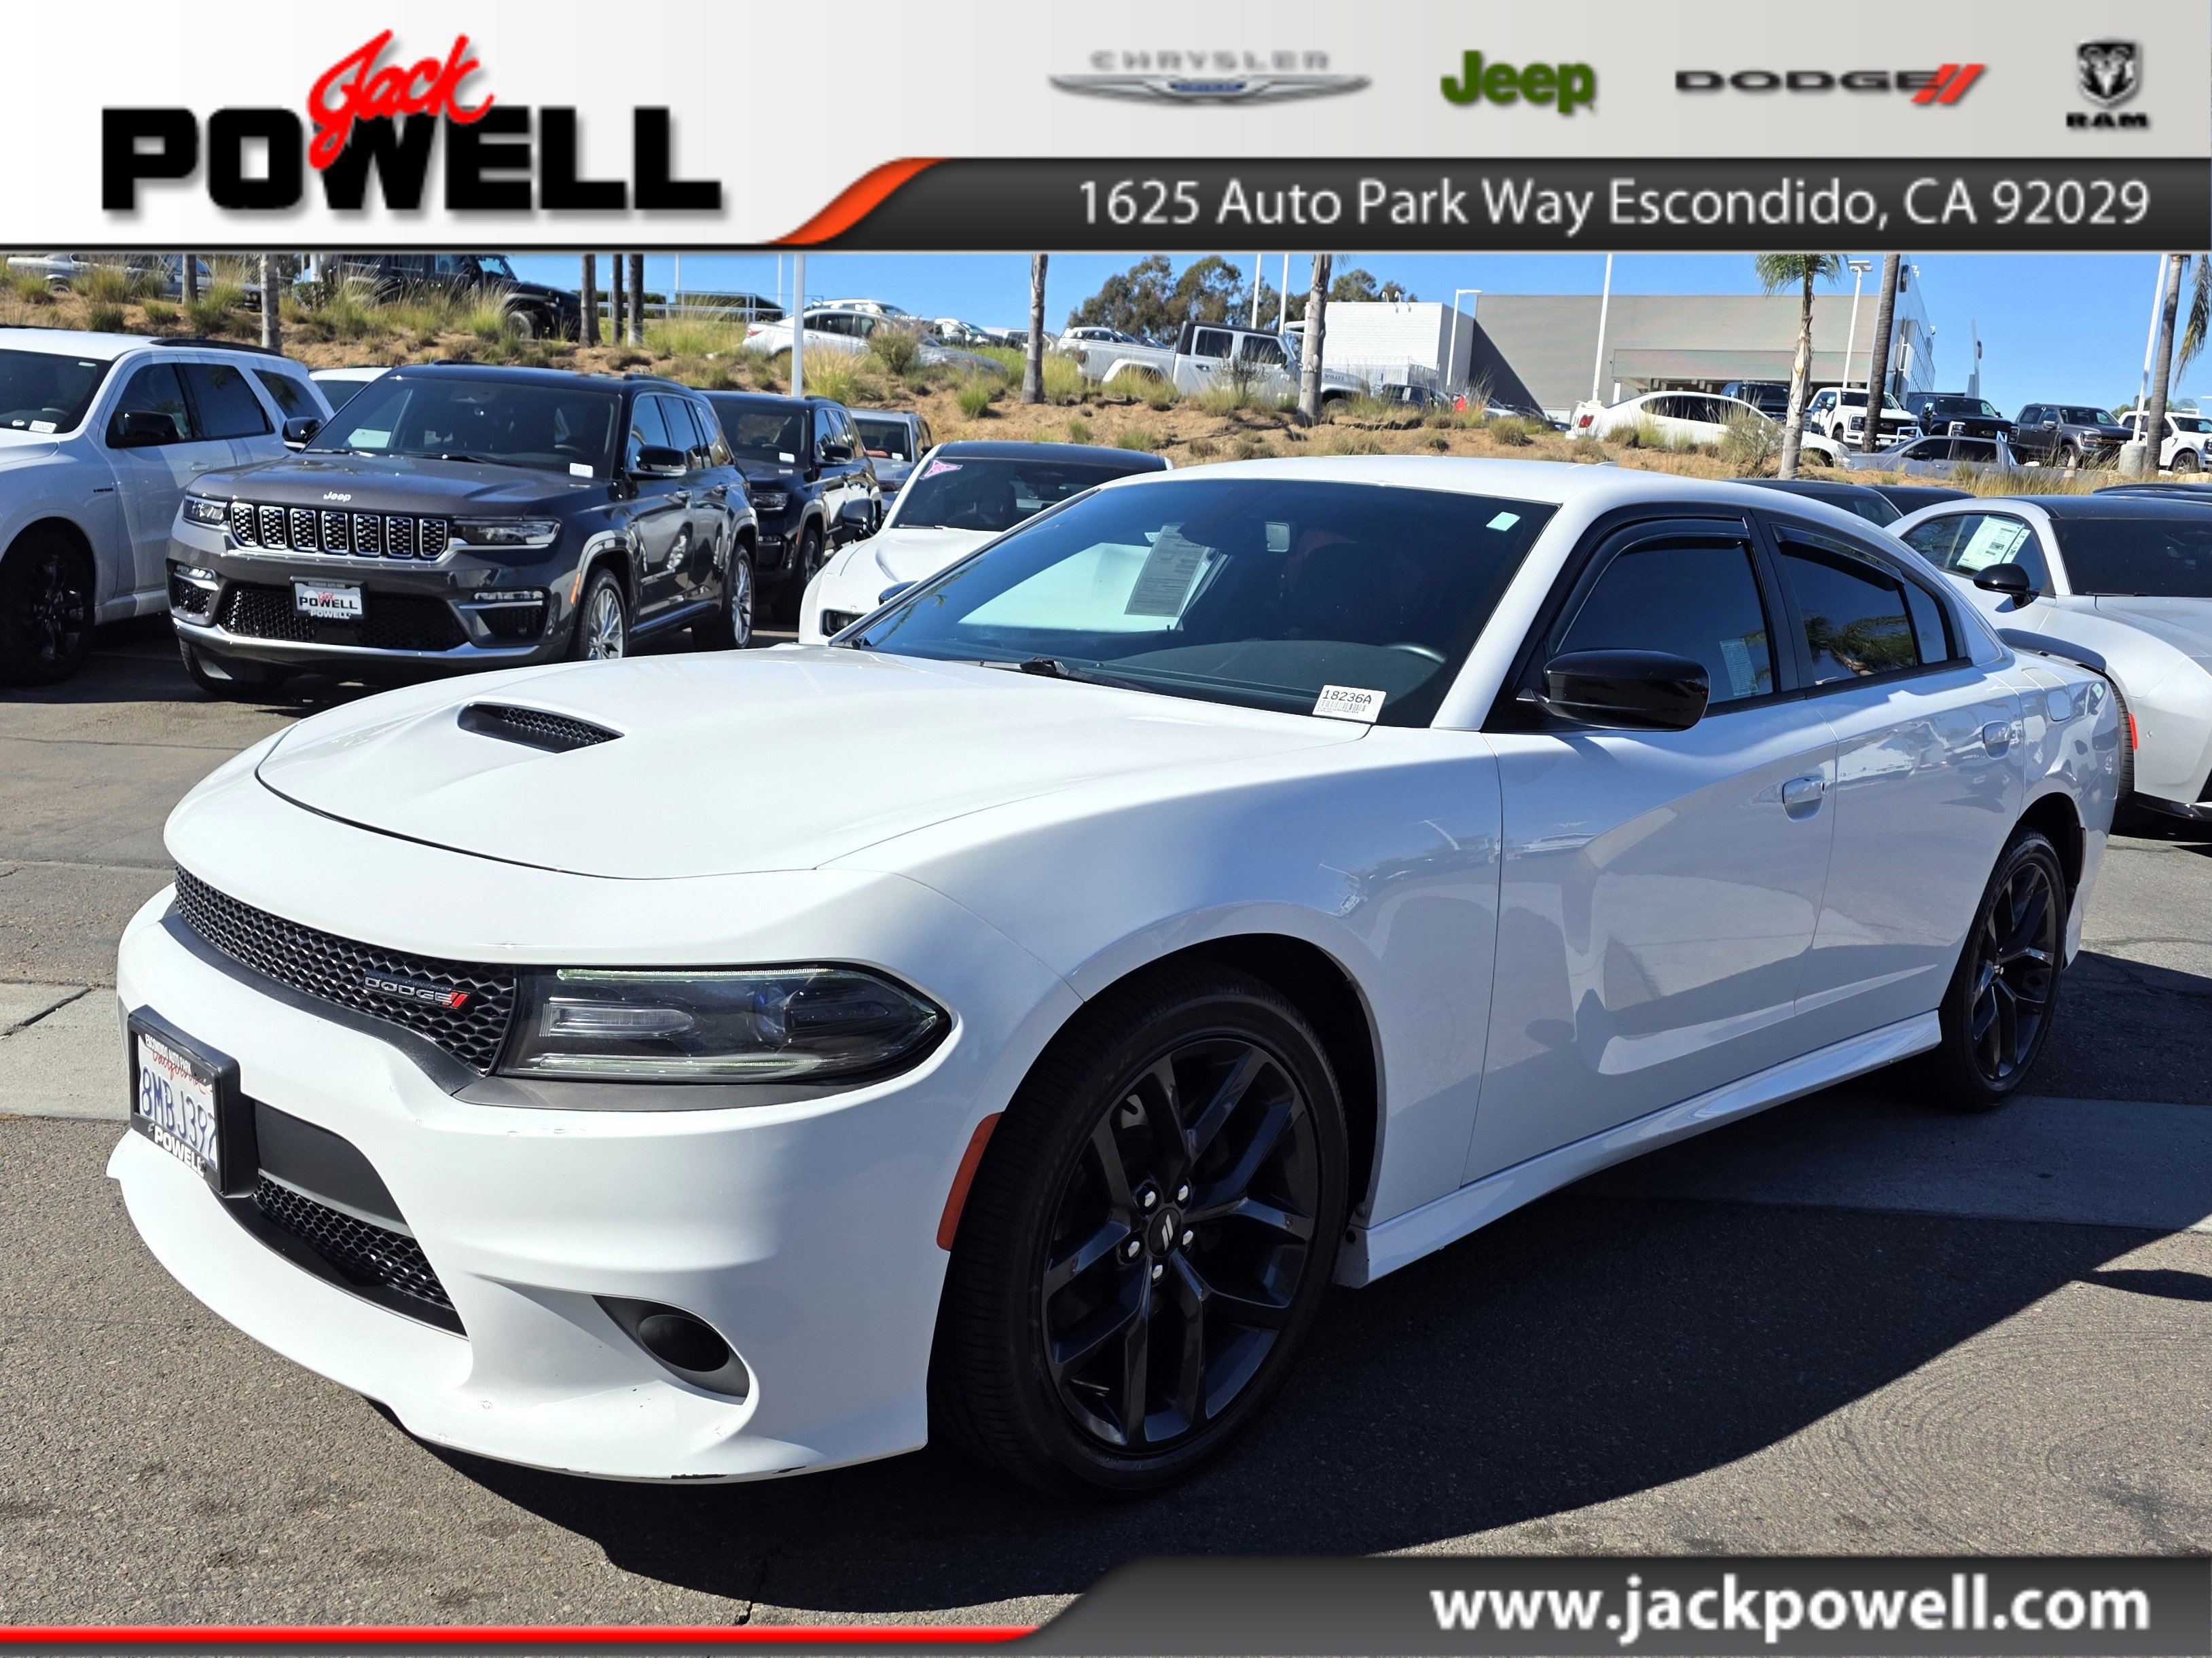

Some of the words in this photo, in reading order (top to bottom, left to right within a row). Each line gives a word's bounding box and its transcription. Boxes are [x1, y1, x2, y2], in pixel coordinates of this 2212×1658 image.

[323, 491, 352, 502] Jeep
[299, 596, 358, 610] POWELL
[310, 610, 350, 620] POWELL
[1322, 689, 1372, 705] 18236A
[365, 976, 453, 1004] DODGE
[153, 1124, 205, 1178] POWELL
